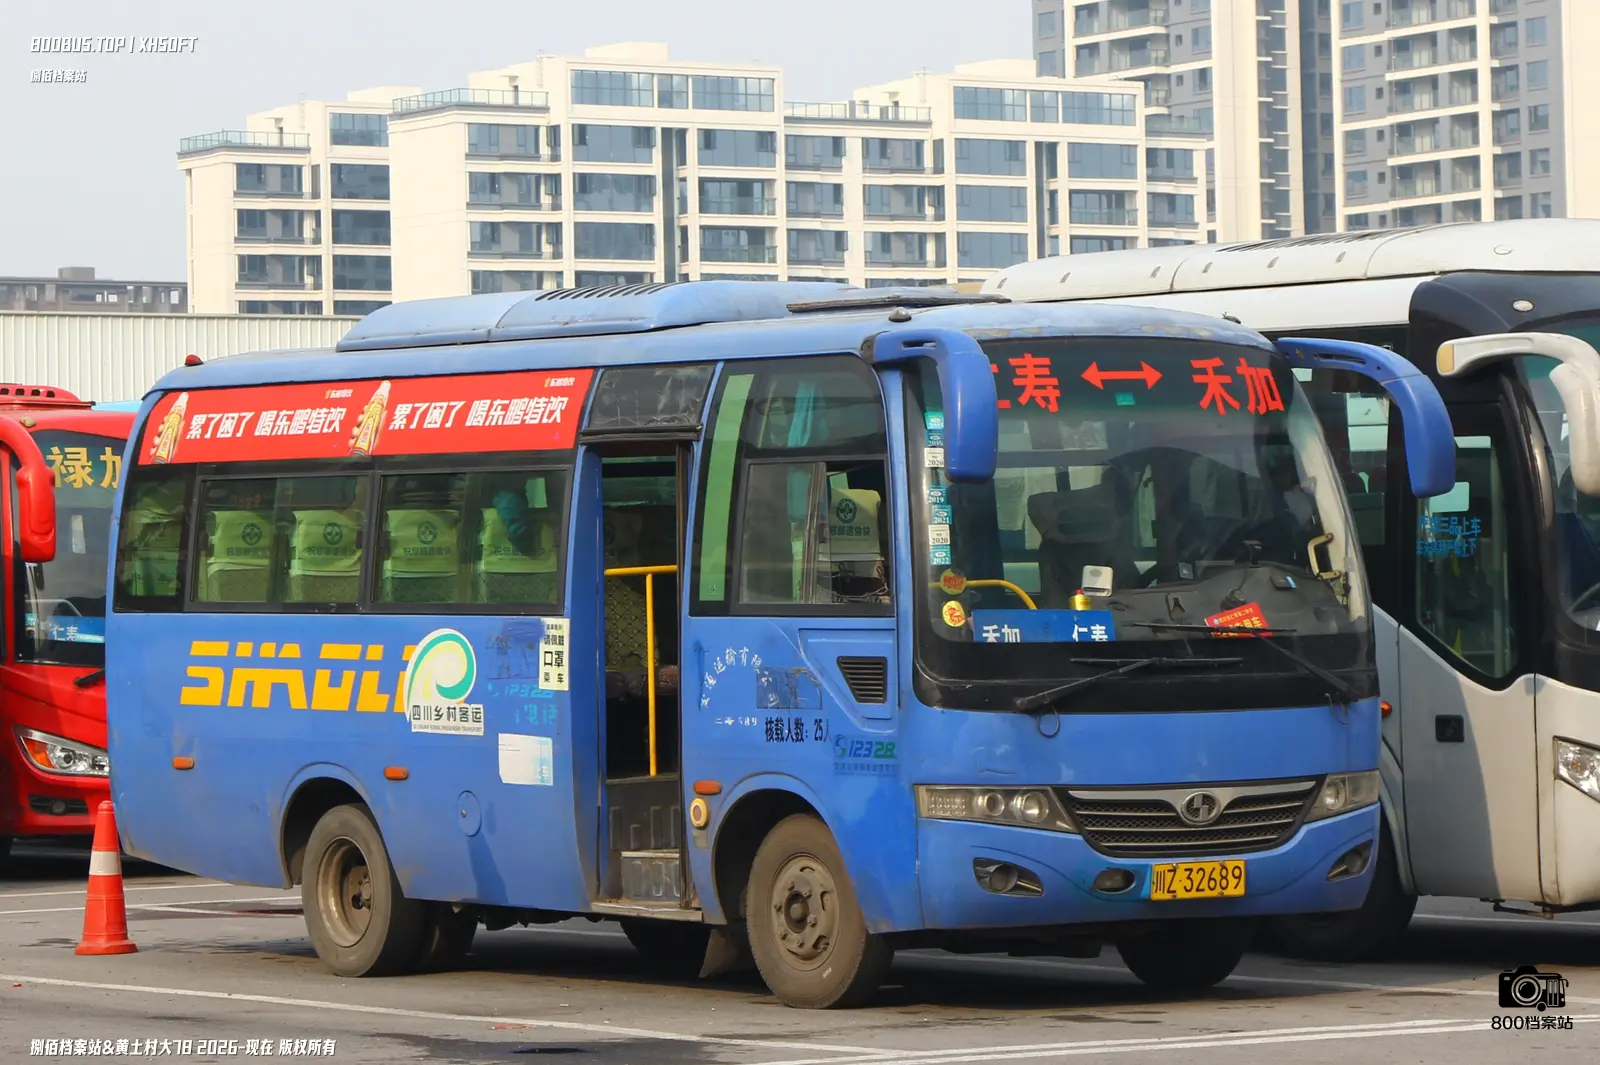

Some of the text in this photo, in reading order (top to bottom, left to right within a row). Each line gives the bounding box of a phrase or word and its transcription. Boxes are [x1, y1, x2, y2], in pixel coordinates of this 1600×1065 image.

[1190, 357, 1285, 416] 禾加
[186, 412, 255, 439] 累了困了
[254, 406, 347, 437] 喝东鹏特饮
[389, 396, 568, 430] 累了困了 喝东鹏特饮
[927, 496, 945, 504] 2019
[932, 557, 950, 565] 2022
[1071, 623, 1108, 642] 仁寿
[543, 650, 564, 668] 口罩
[543, 671, 565, 684] 乘 车
[412, 704, 482, 723] 四川乡村客运
[848, 740, 897, 760] 12328
